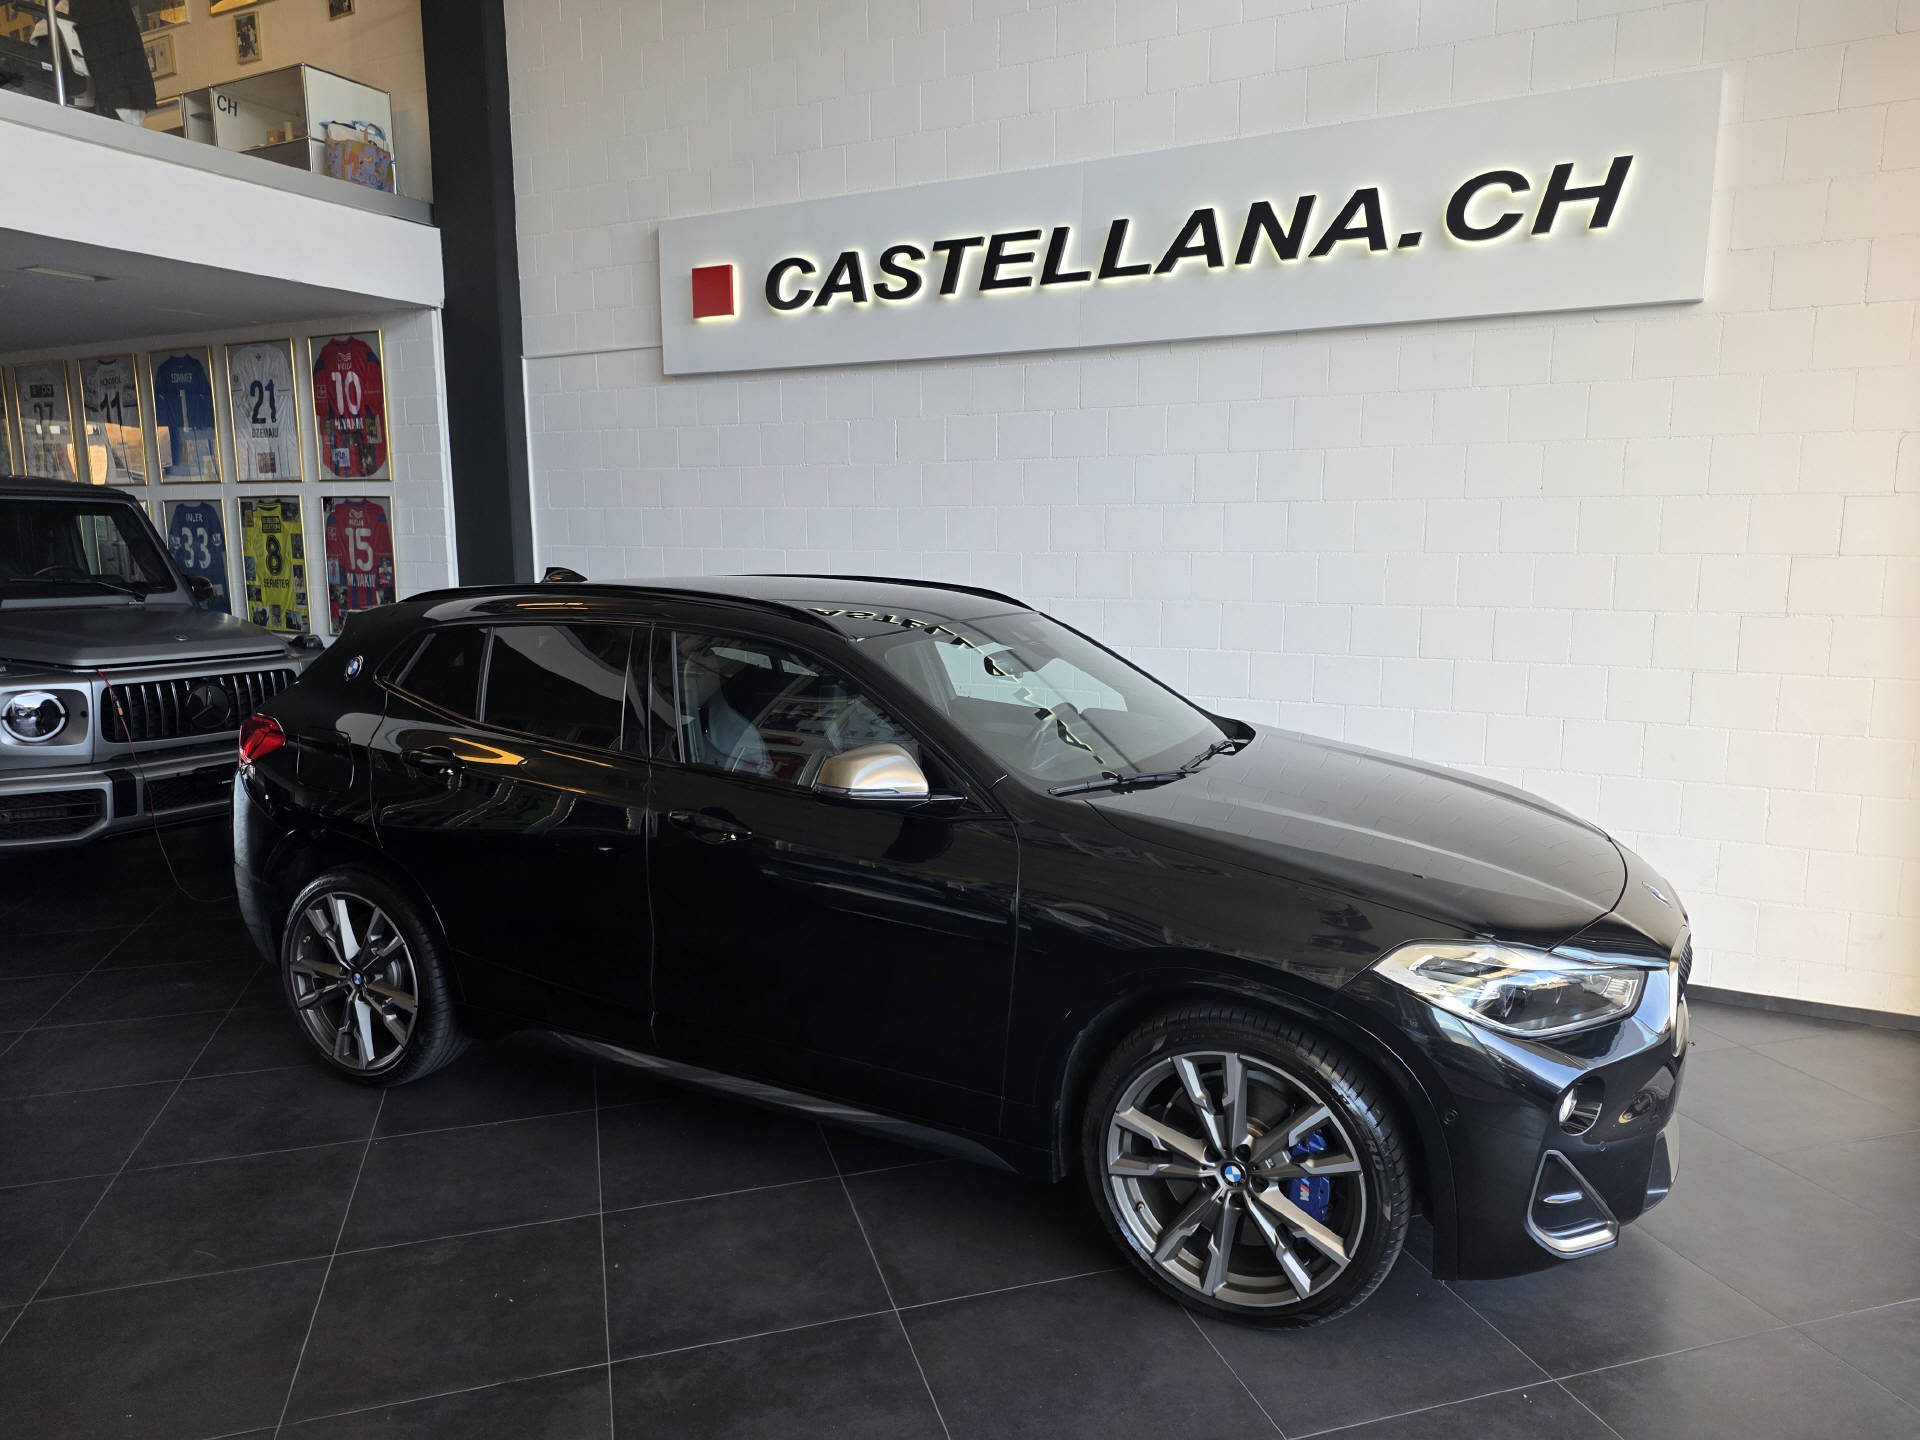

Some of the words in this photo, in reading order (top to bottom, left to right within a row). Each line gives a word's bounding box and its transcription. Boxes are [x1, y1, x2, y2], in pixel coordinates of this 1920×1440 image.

[217, 95, 238, 117] CH
[764, 155, 1634, 312] CASTELLANA.CH
[100, 391, 123, 425] 11
[180, 389, 190, 432] 1
[249, 379, 277, 424] 21
[331, 371, 361, 415] 10
[182, 527, 211, 569] 33
[266, 535, 283, 576] 8
[345, 527, 374, 571] 15
